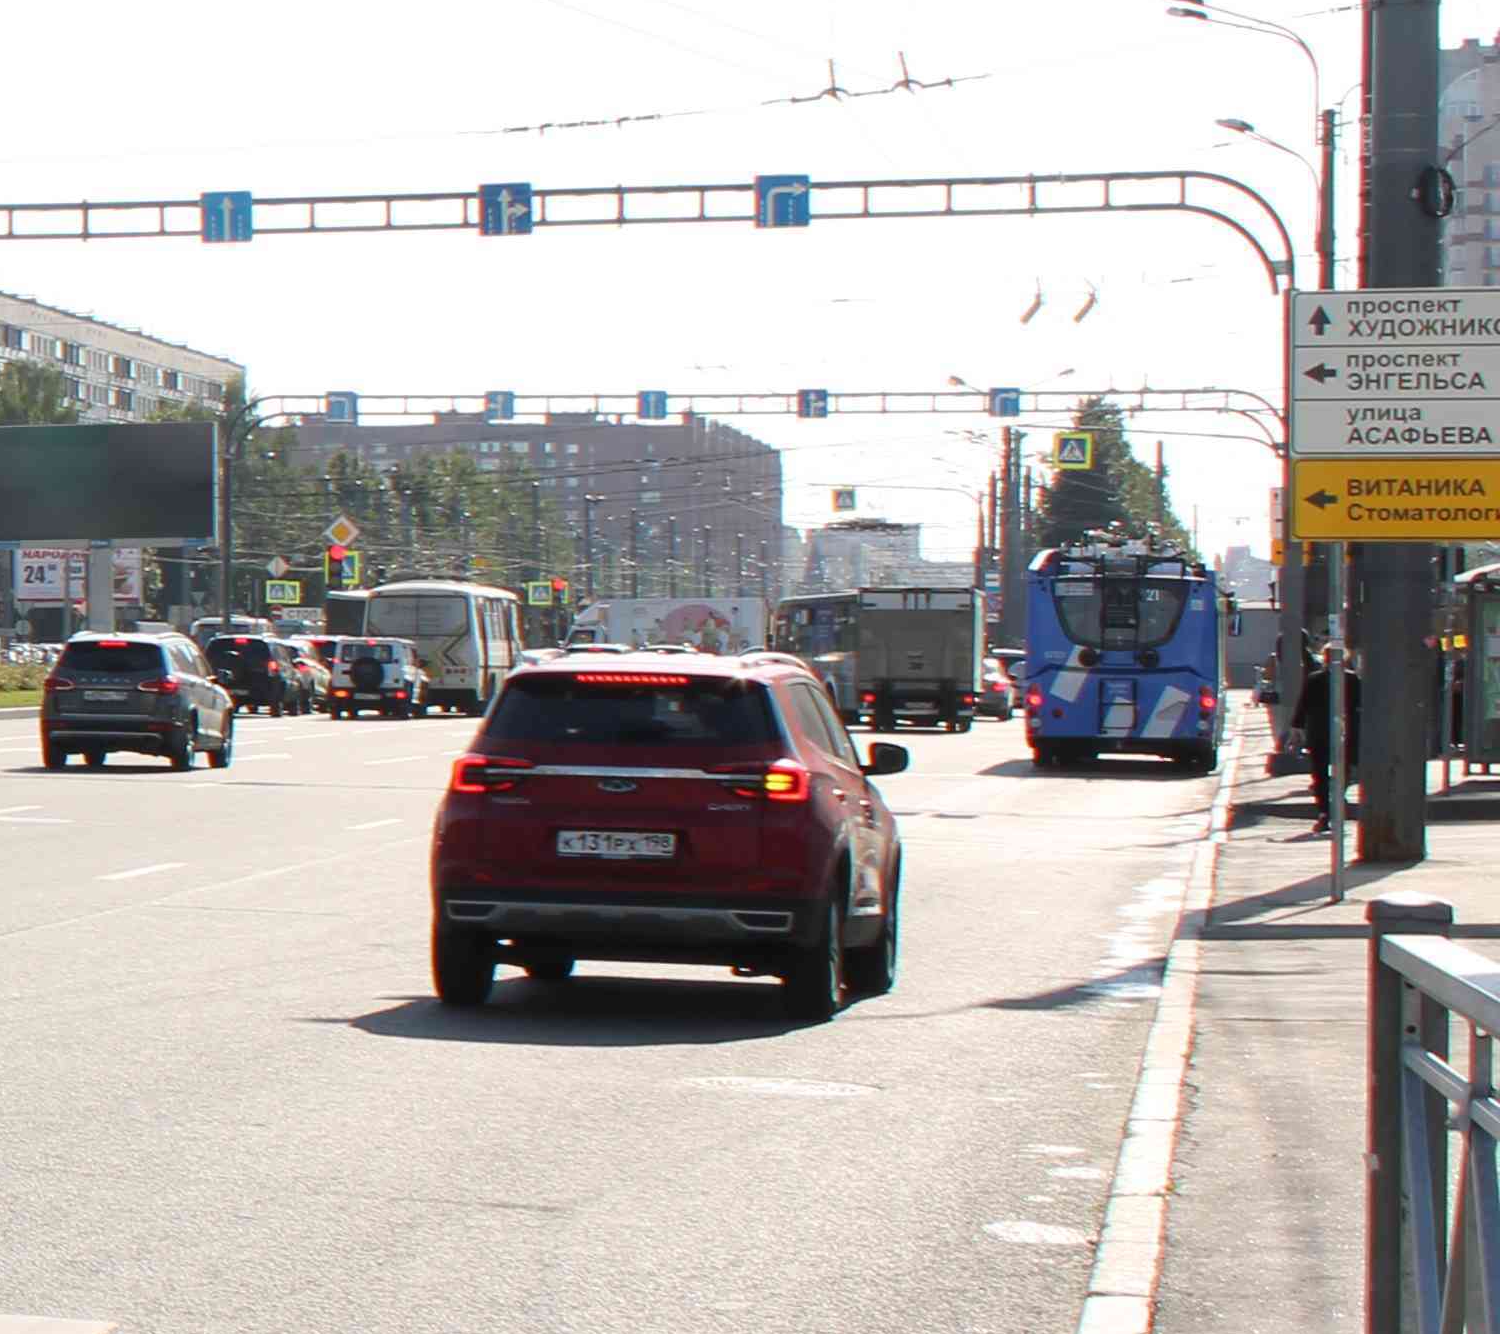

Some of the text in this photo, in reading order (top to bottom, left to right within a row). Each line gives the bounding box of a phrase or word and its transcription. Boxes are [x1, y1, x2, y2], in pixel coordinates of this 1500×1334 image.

[1347, 299, 1460, 318] проспект
[1347, 353, 1460, 371] проспект
[1347, 372, 1485, 391] ЭНГЕЛЬСА
[1347, 406, 1421, 424] улица
[1347, 427, 1492, 445] АСАФЬЕВА
[1347, 479, 1486, 496] ВИТАНИКА
[23, 565, 45, 584] 24
